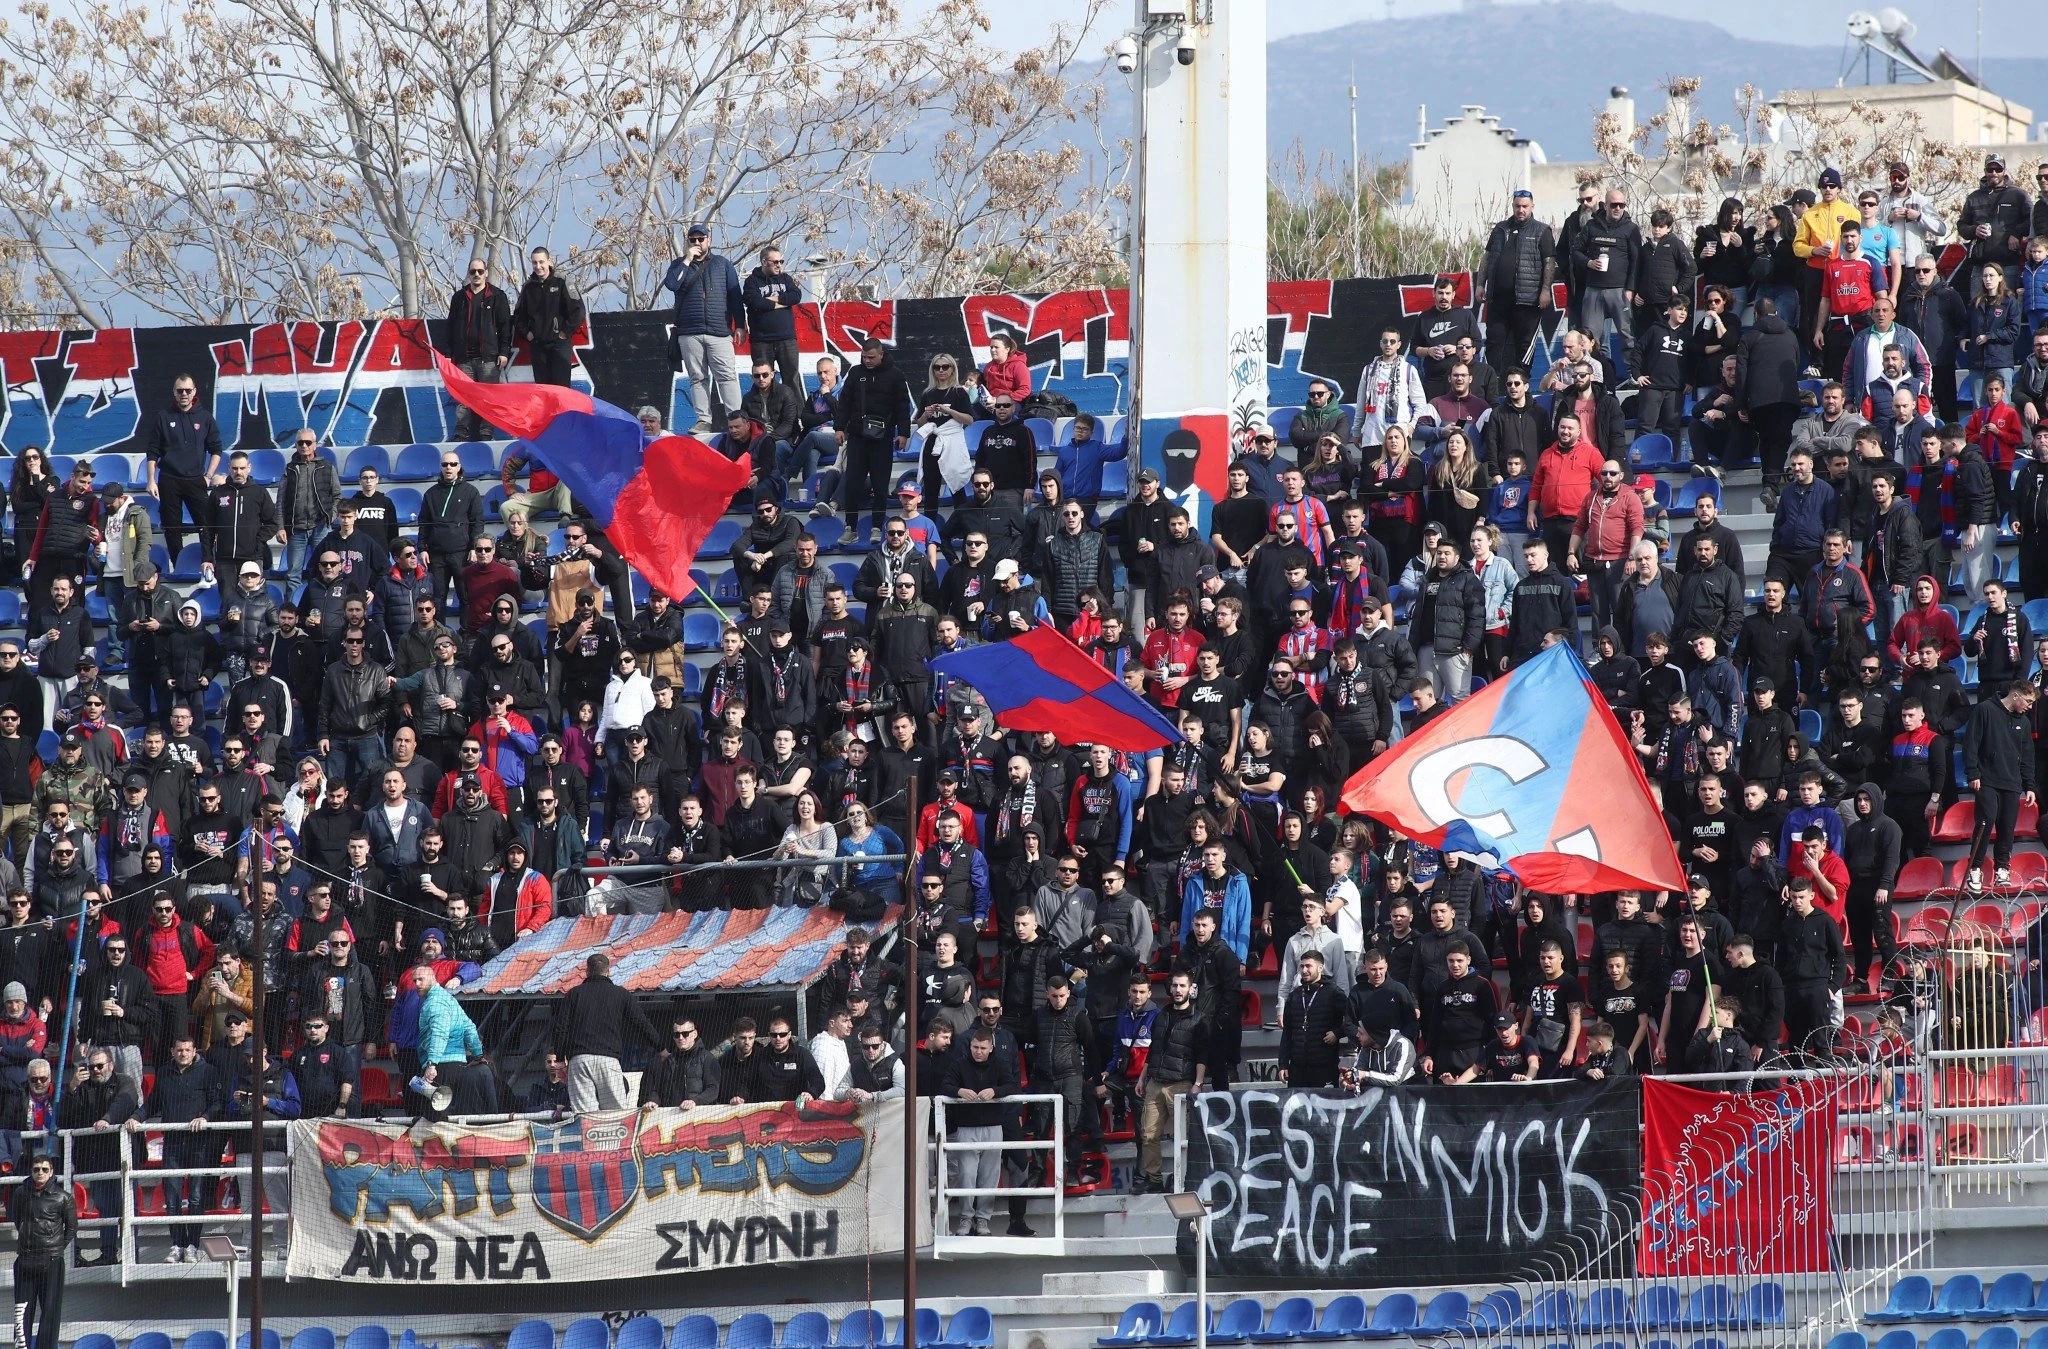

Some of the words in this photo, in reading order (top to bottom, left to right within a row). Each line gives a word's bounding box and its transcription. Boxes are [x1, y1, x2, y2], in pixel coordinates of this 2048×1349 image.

[1837, 286, 1860, 295] WIND
[356, 508, 386, 520] VANS
[747, 627, 762, 636] 210
[1196, 686, 1213, 695] JUST
[1383, 1095, 1430, 1190] IN
[1431, 1117, 1609, 1248] MICK
[1196, 1170, 1383, 1271] PEACE
[341, 1228, 439, 1281] ΑΝΩ
[454, 1231, 552, 1281] ΝΕΑ
[655, 1209, 840, 1271] ΣΜΥΡΝΗ
